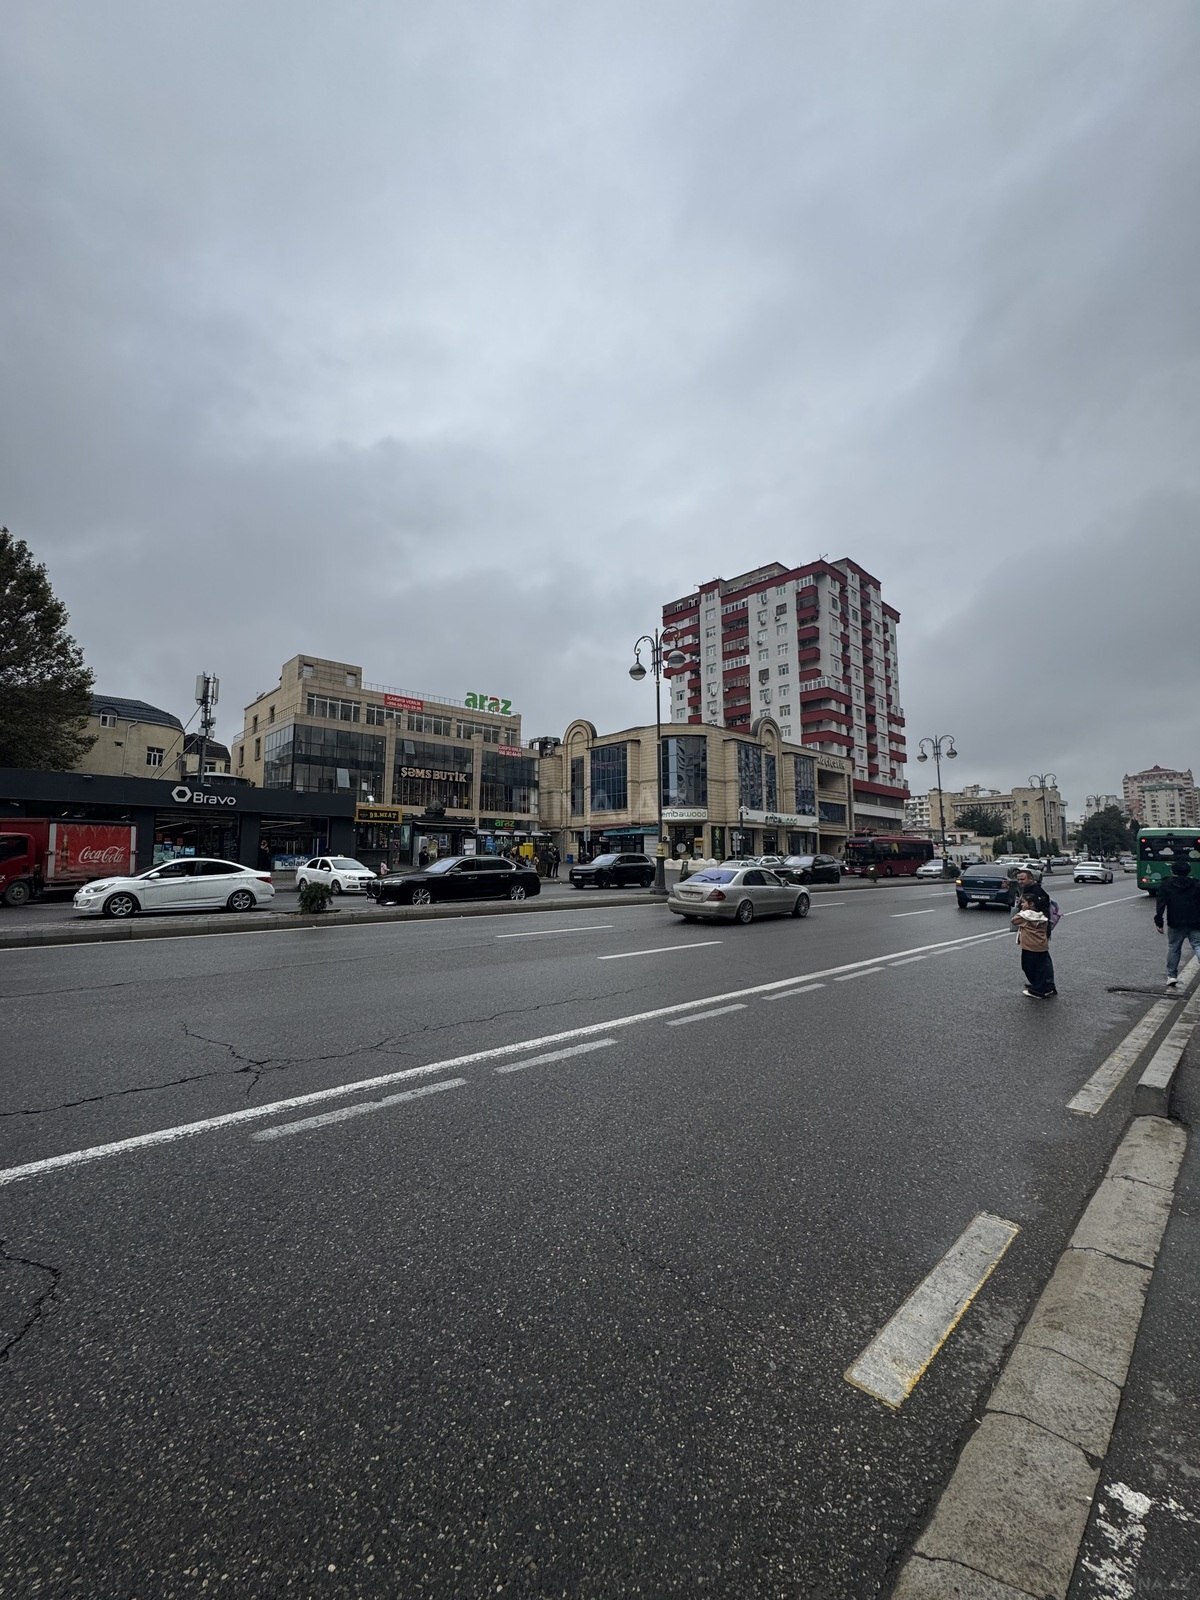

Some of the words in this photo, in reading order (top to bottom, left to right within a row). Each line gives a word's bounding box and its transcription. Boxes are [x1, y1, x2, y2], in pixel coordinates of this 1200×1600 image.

[465, 692, 512, 715] araz
[401, 767, 432, 779] ŞƏMS
[432, 769, 467, 783] BUTİK
[192, 791, 237, 806] Bravo
[662, 810, 706, 818] embawood
[494, 819, 515, 828] araz
